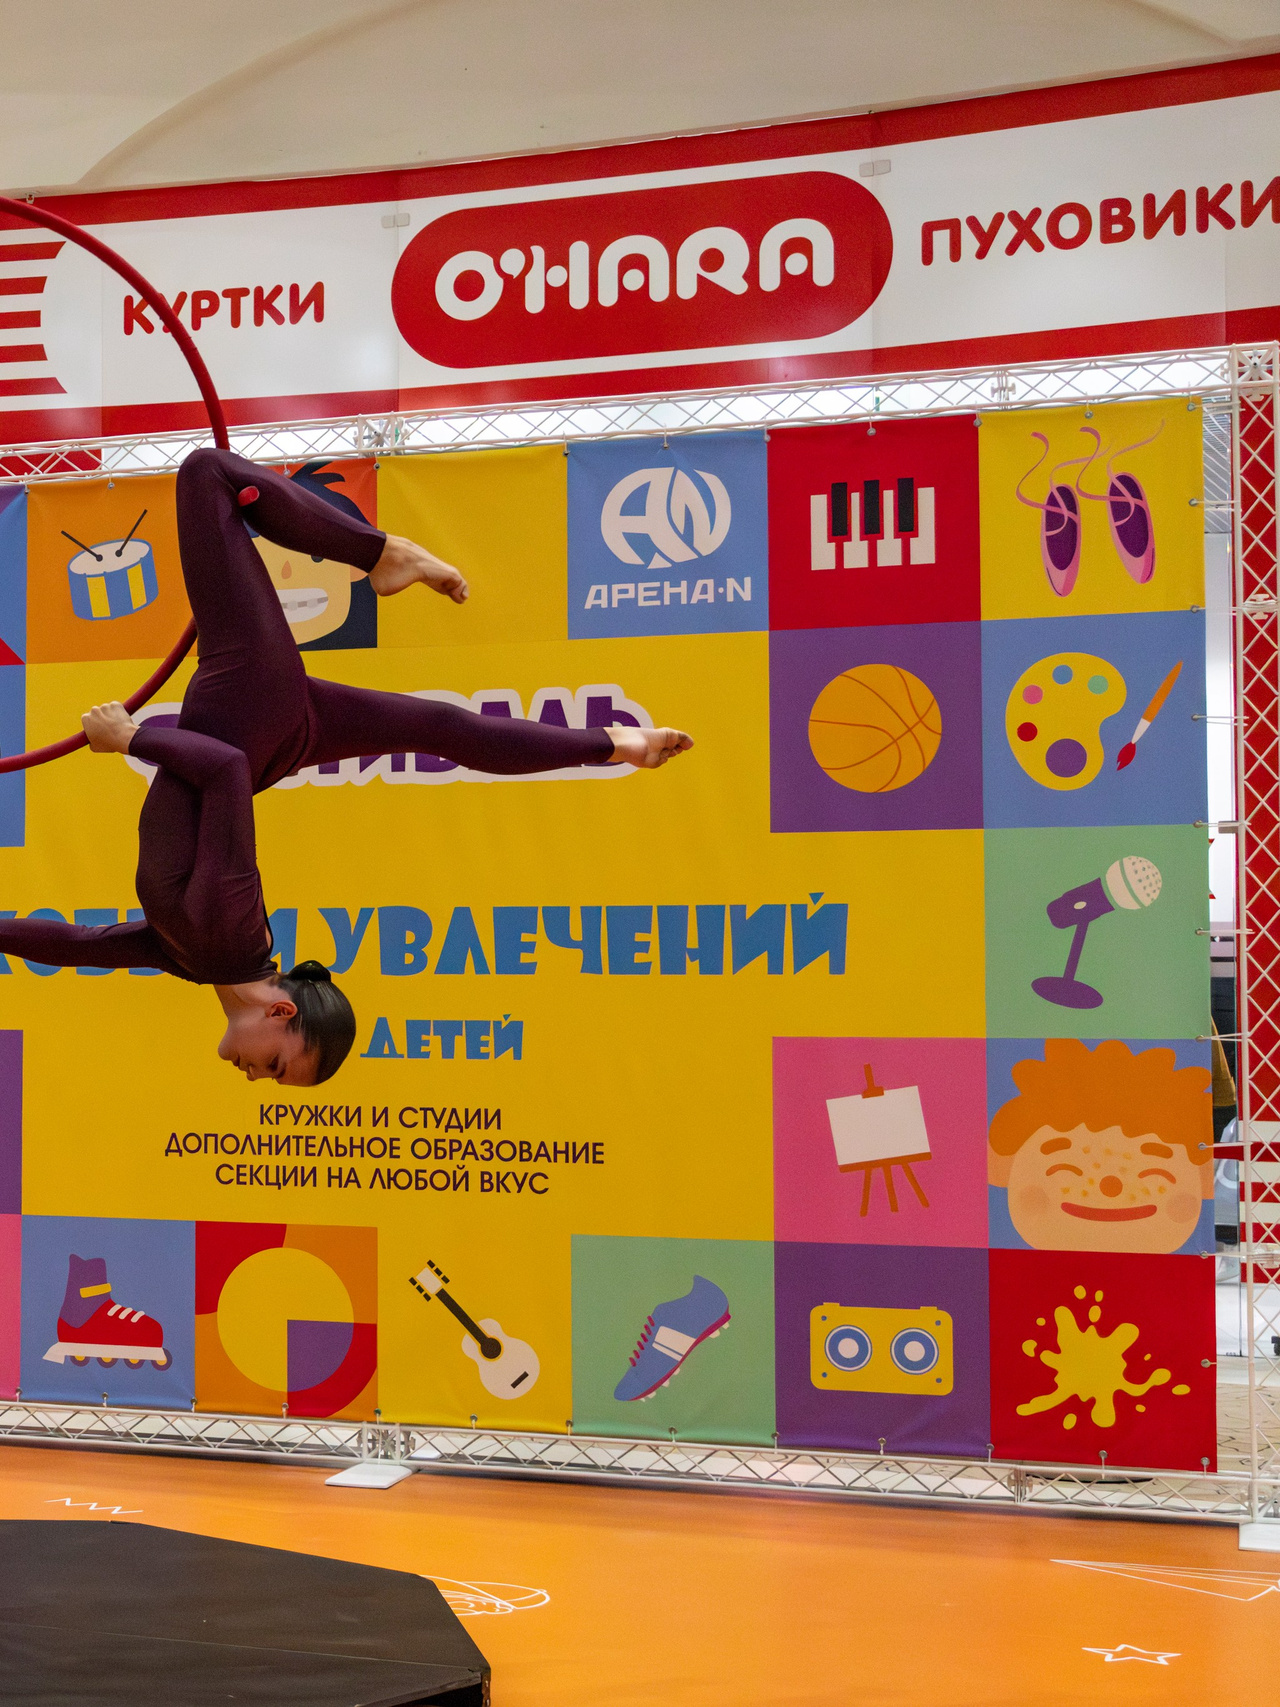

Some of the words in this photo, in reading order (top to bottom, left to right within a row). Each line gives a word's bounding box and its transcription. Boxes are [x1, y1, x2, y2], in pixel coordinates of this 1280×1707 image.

[921, 176, 1280, 266] ПУХОВИКИ
[317, 892, 848, 976] УВЛЕЧЕНИЙ
[360, 1014, 524, 1060] ДЕТЕЙ
[259, 1104, 362, 1127] КРУЖКИ
[372, 1106, 389, 1128] И
[398, 1106, 502, 1133] СТУДИИ
[165, 1132, 401, 1159] ДОПОЛНИТЕЛЬНОЕ
[410, 1137, 605, 1164] ОБРАЗОВАНИЕ
[215, 1163, 317, 1190] СЕКЦИИ
[327, 1166, 362, 1188] НА
[369, 1164, 469, 1192] ЛЮБОЙ
[480, 1171, 549, 1194] ВКУС
